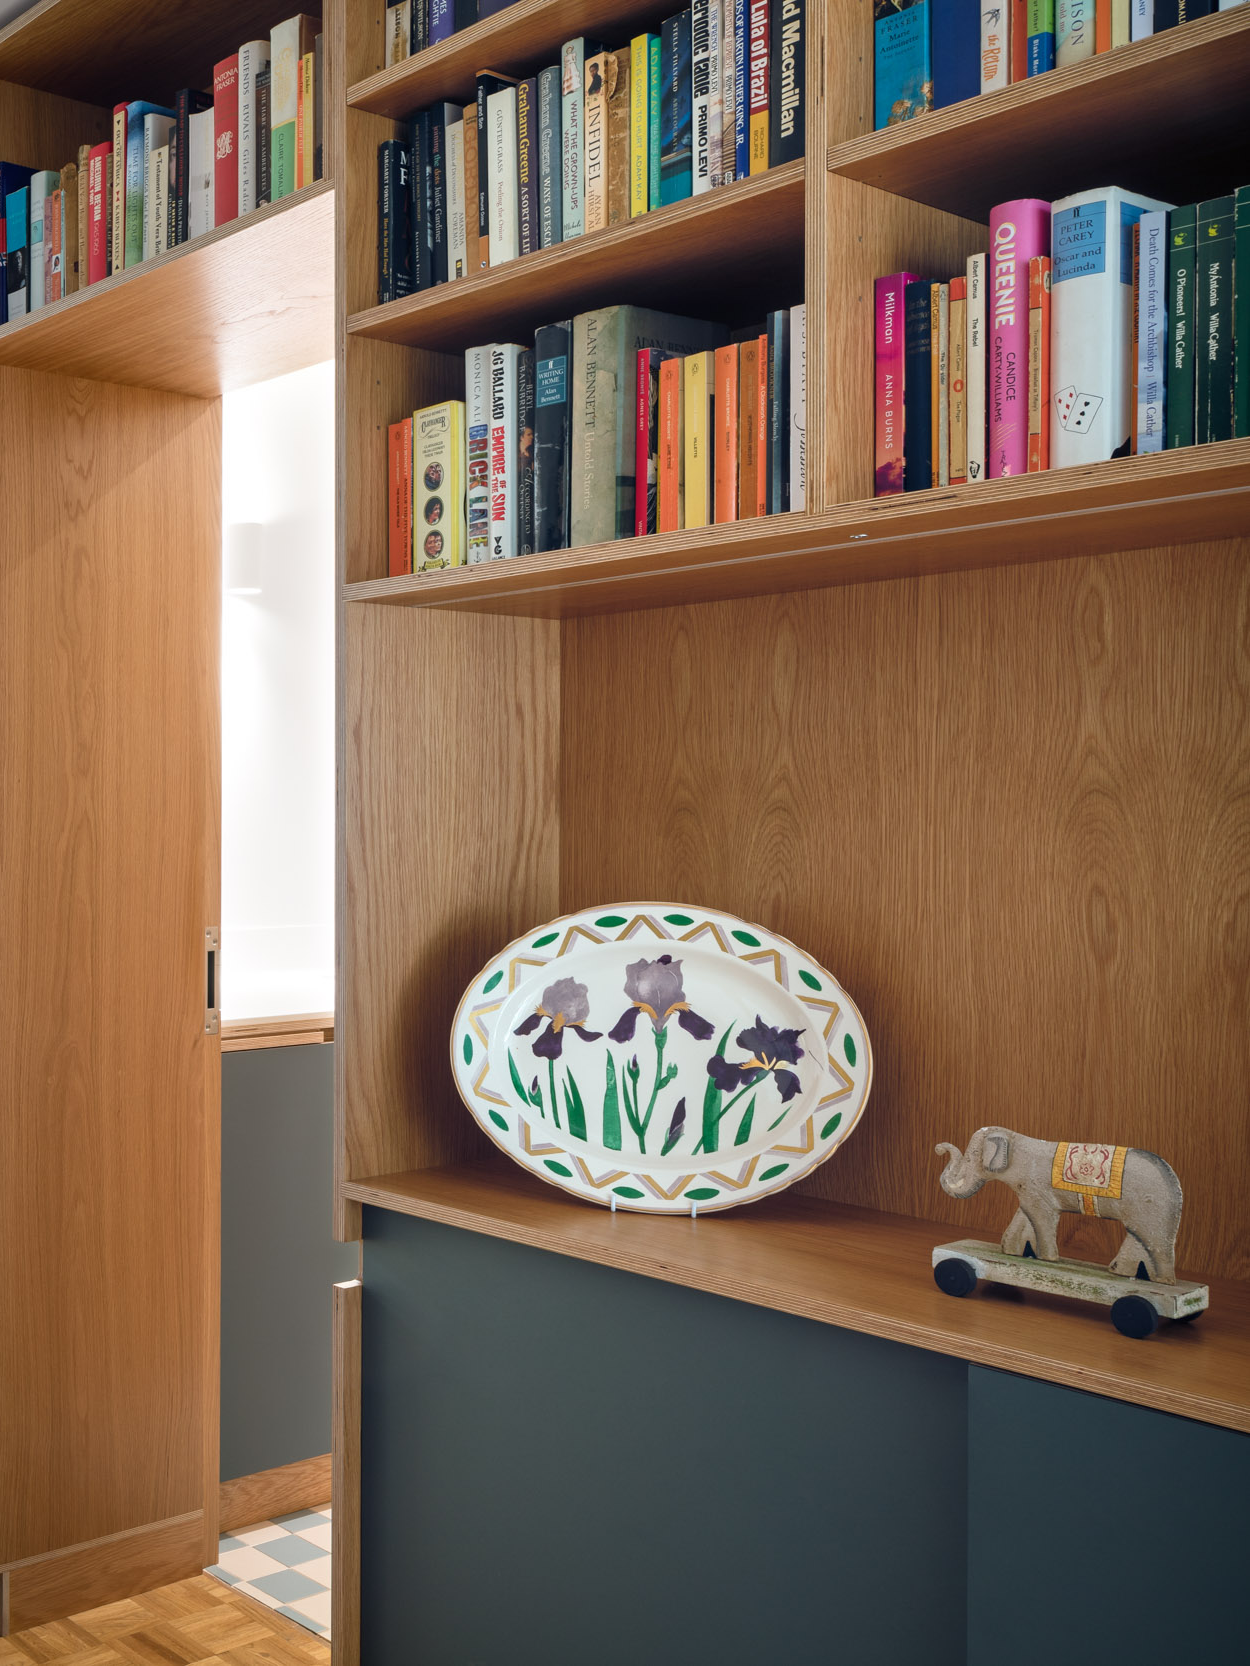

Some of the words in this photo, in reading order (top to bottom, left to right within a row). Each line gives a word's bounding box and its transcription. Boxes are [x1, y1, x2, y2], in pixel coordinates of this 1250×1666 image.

[751, 0, 768, 39] Lula
[881, 16, 918, 35] FRASER
[1060, 22, 1066, 33] me
[751, 40, 768, 58] of
[880, 35, 919, 55] Antoinette
[890, 30, 910, 42] Marie
[988, 35, 1000, 47] the
[214, 67, 238, 86] ANTONIA
[216, 78, 236, 92] FRASER
[242, 50, 250, 96] FRIENDS
[636, 68, 642, 77] IS
[725, 75, 733, 96] PRIMO
[750, 60, 768, 109] Brazil
[781, 20, 799, 138] Macmillan
[518, 84, 530, 138] Graham
[540, 72, 552, 128] Graham
[570, 100, 578, 128] WHAT
[725, 96, 733, 112] LEVI
[242, 104, 250, 141] RIVALS
[636, 111, 642, 123] TO
[698, 104, 708, 146] PRIMO
[115, 147, 121, 156] OF
[432, 126, 442, 154] joining
[541, 129, 552, 176] Greene
[588, 104, 601, 188] INFIDEL
[94, 156, 102, 193] ANEURIN
[434, 154, 442, 167] the
[520, 138, 530, 184] Greene
[698, 148, 708, 178] LEVI
[434, 168, 442, 184] dots
[570, 153, 578, 210] GROWN-UPS
[434, 186, 442, 207] Juliet
[495, 181, 504, 207] Peeling
[434, 208, 443, 243] Gardiner
[497, 208, 505, 219] the
[1061, 220, 1093, 235] PETER
[497, 220, 505, 241] Onion
[1059, 230, 1094, 246] CAREY
[1148, 228, 1159, 255] Death
[1054, 253, 1079, 266] Oscar
[1082, 247, 1102, 258] and
[1058, 262, 1096, 278] Lucinda
[1209, 262, 1220, 274] My
[994, 222, 1017, 329] QUEENIE
[1148, 258, 1158, 288] Comes
[1148, 290, 1158, 303] for
[1176, 278, 1186, 317] Pioneers!
[1209, 274, 1222, 307] Ántonia
[885, 292, 895, 344] Milkman
[1148, 304, 1158, 319] the
[1210, 313, 1220, 333] Willa
[586, 318, 598, 356] ALAN
[1176, 320, 1186, 341] Willa
[492, 351, 504, 366] JG
[1144, 321, 1158, 372] Archbishop
[1175, 342, 1185, 369] Cather
[1207, 333, 1219, 361] Cather
[538, 368, 564, 379] WRITING
[542, 377, 560, 386] HOME
[994, 336, 1002, 423] CARTY-WILLIAMS
[1006, 352, 1016, 401] CANDICE
[492, 367, 505, 420] BALLARD
[518, 366, 526, 433] BAINBRIDGE
[541, 394, 561, 403] Bennett
[544, 388, 557, 396] Alan
[585, 362, 598, 428] BENNETT
[885, 374, 893, 406] ANNA
[1146, 382, 1157, 404] Willa
[885, 411, 893, 449] BURNS
[1146, 408, 1157, 437] Cather
[469, 424, 488, 490] BRICK
[492, 426, 506, 475] EMPIRE
[584, 432, 594, 470] Untold
[492, 477, 500, 494] THE
[500, 480, 507, 489] OF
[583, 472, 594, 510] Stories
[492, 493, 506, 522] SUN
[469, 496, 488, 549] LANE
